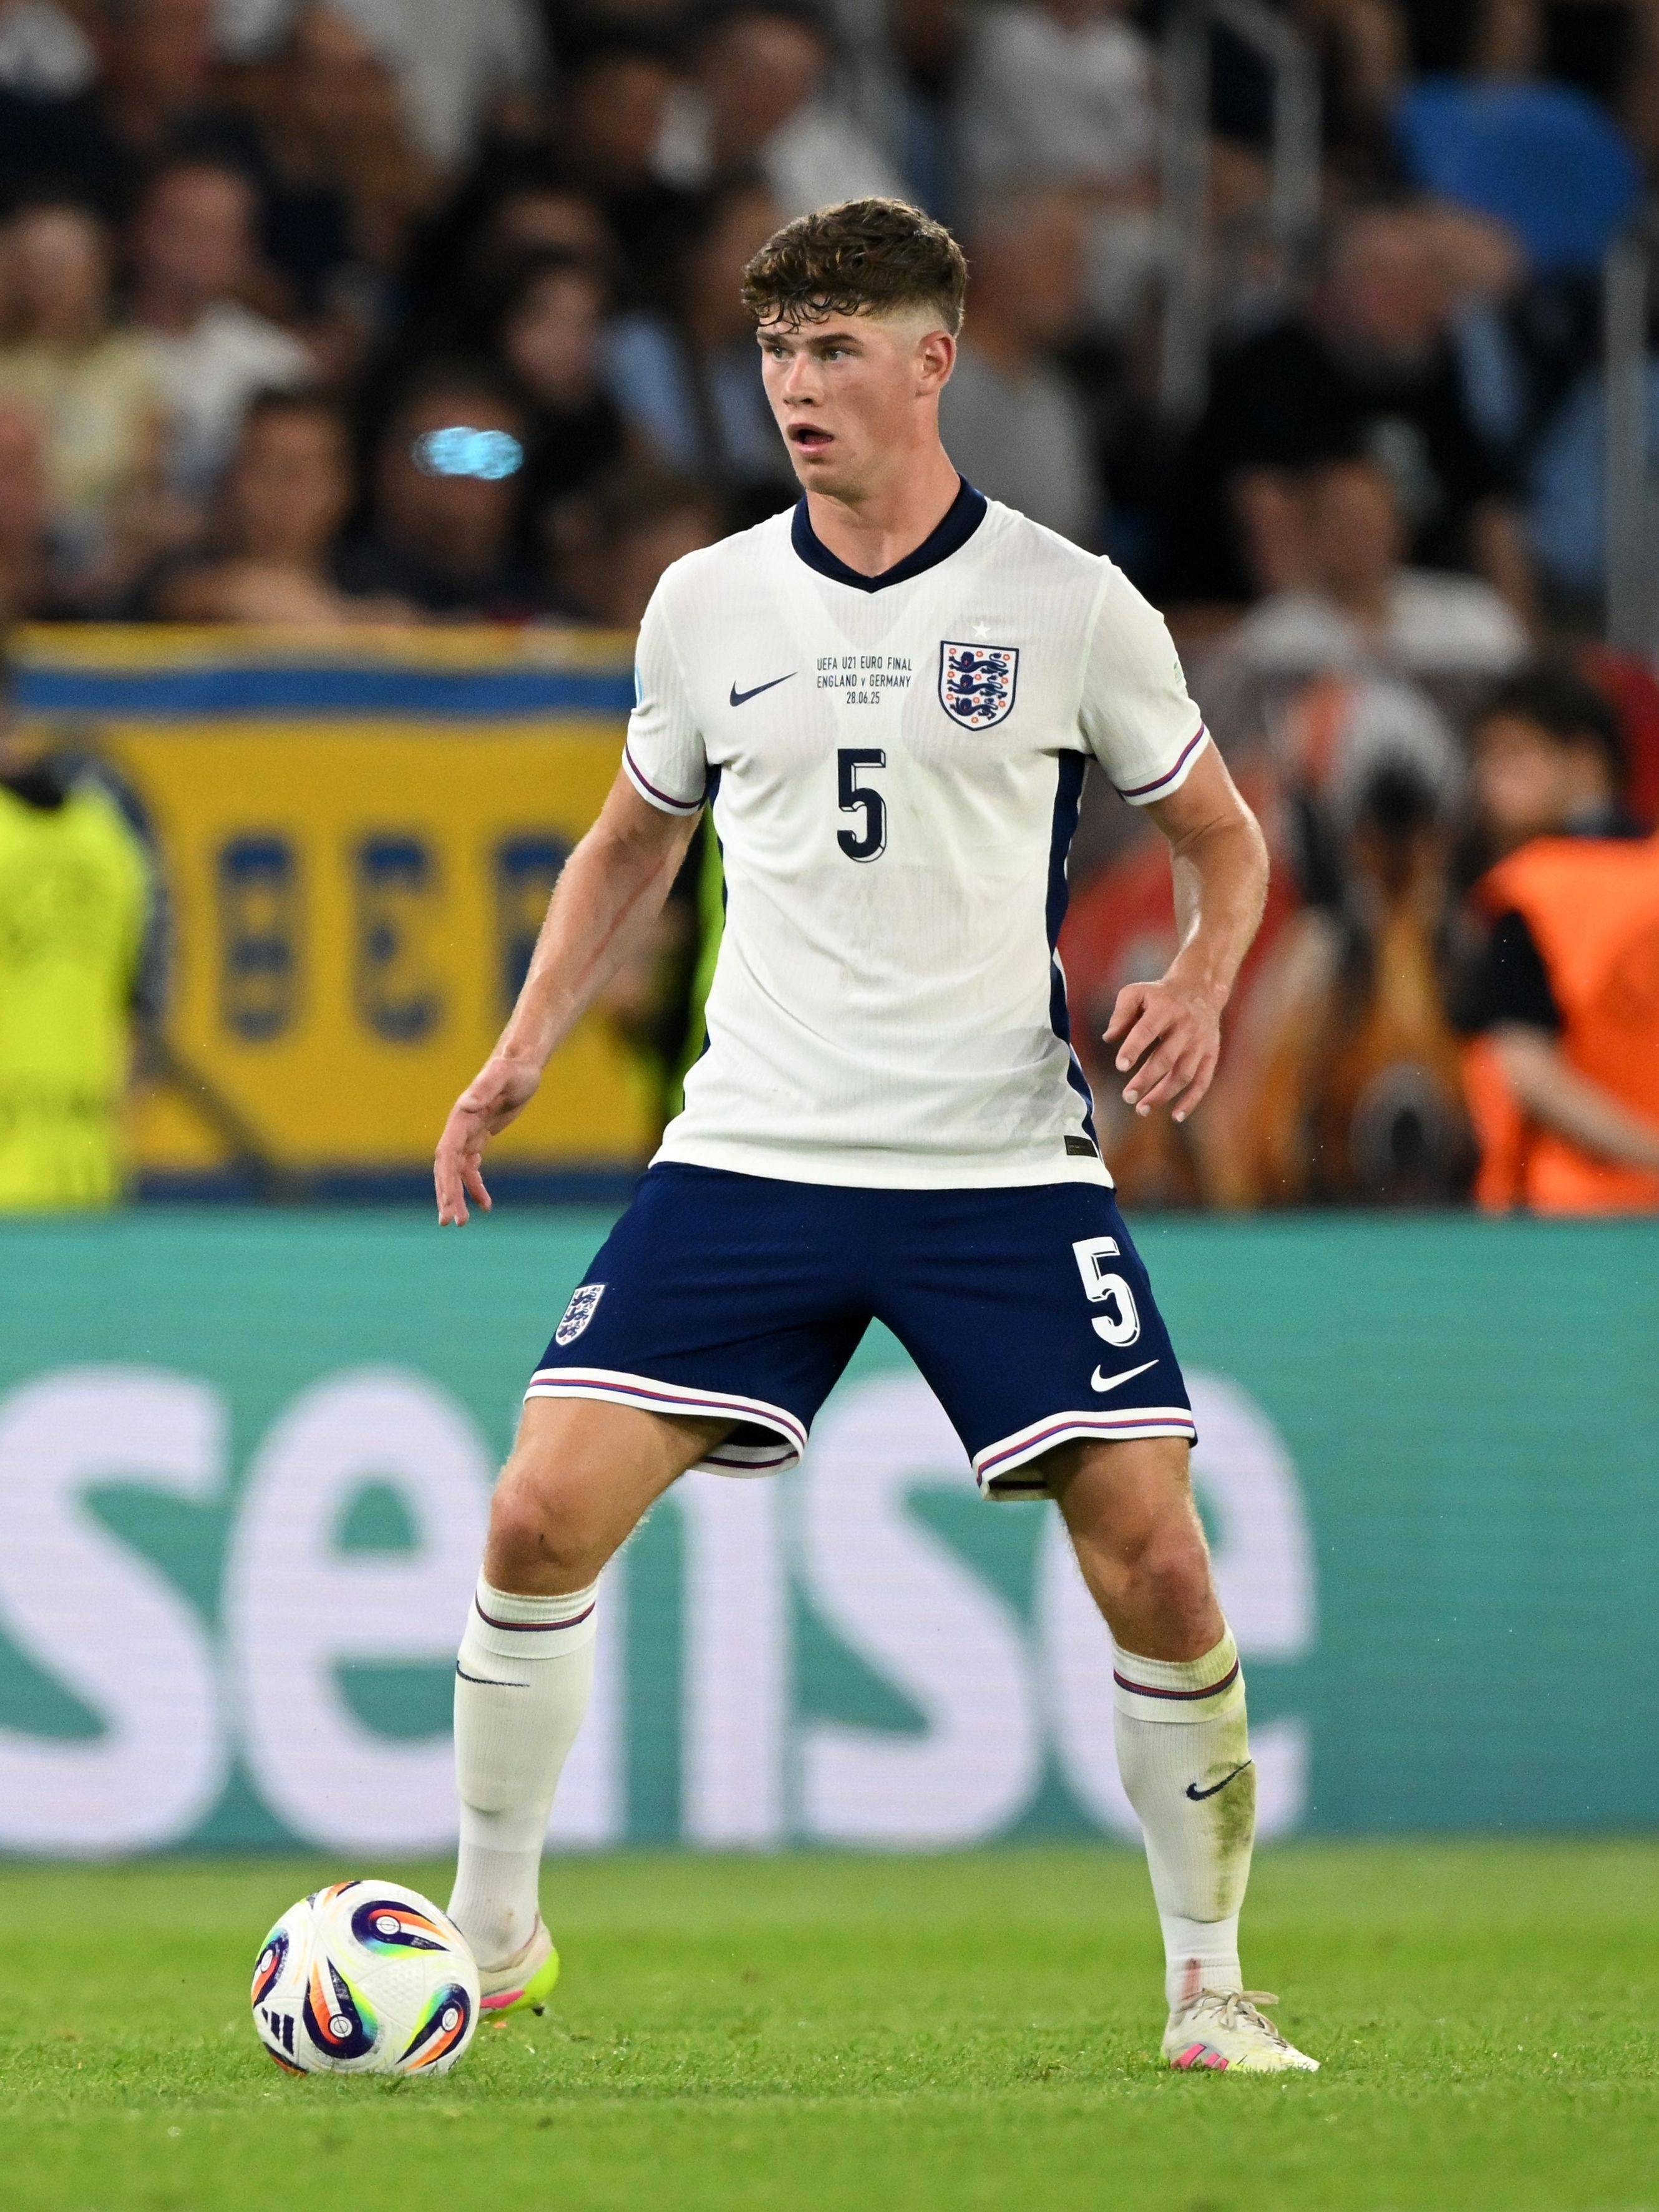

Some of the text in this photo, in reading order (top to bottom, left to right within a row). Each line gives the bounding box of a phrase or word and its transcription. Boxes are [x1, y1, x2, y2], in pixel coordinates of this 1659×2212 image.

[817, 656, 912, 671] UEFA U21 EURO FINAL
[817, 674, 911, 688] ENGLAND v GERMANY
[847, 691, 880, 704] 28.06.25
[837, 748, 887, 863] 5
[1072, 1236, 1141, 1347] 5
